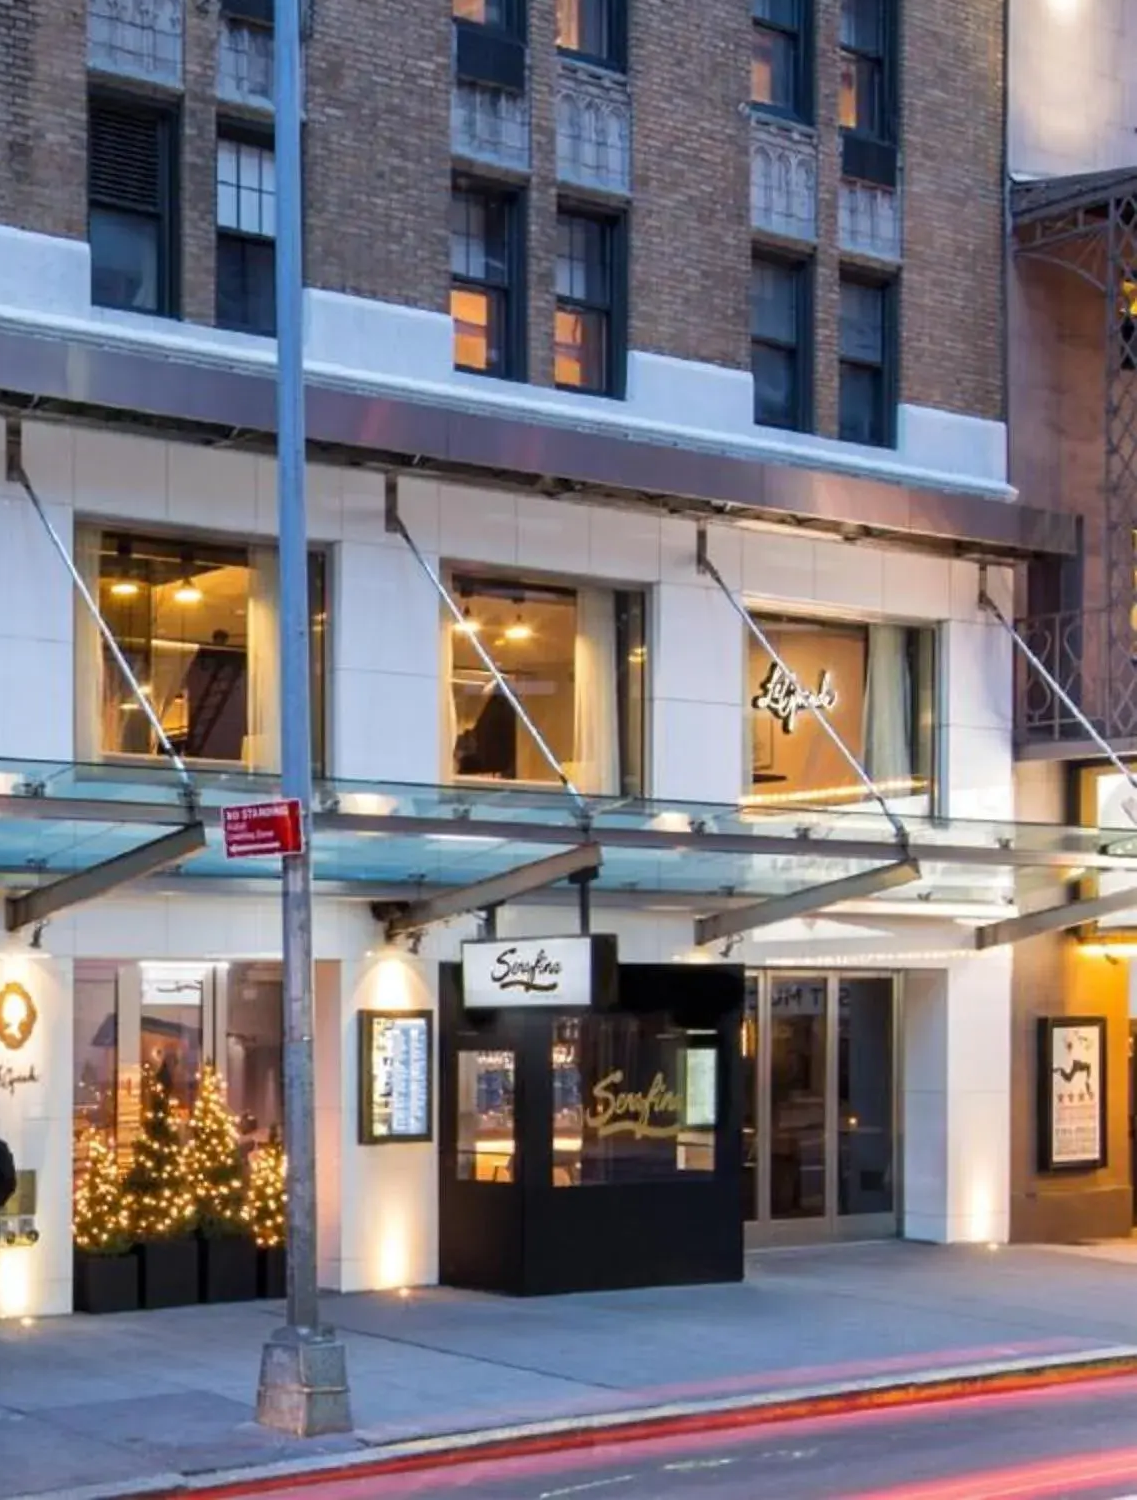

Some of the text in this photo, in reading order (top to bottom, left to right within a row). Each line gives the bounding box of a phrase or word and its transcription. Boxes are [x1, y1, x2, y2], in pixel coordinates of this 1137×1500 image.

[226, 803, 289, 821] NO STANDING
[491, 947, 562, 985] Serafina
